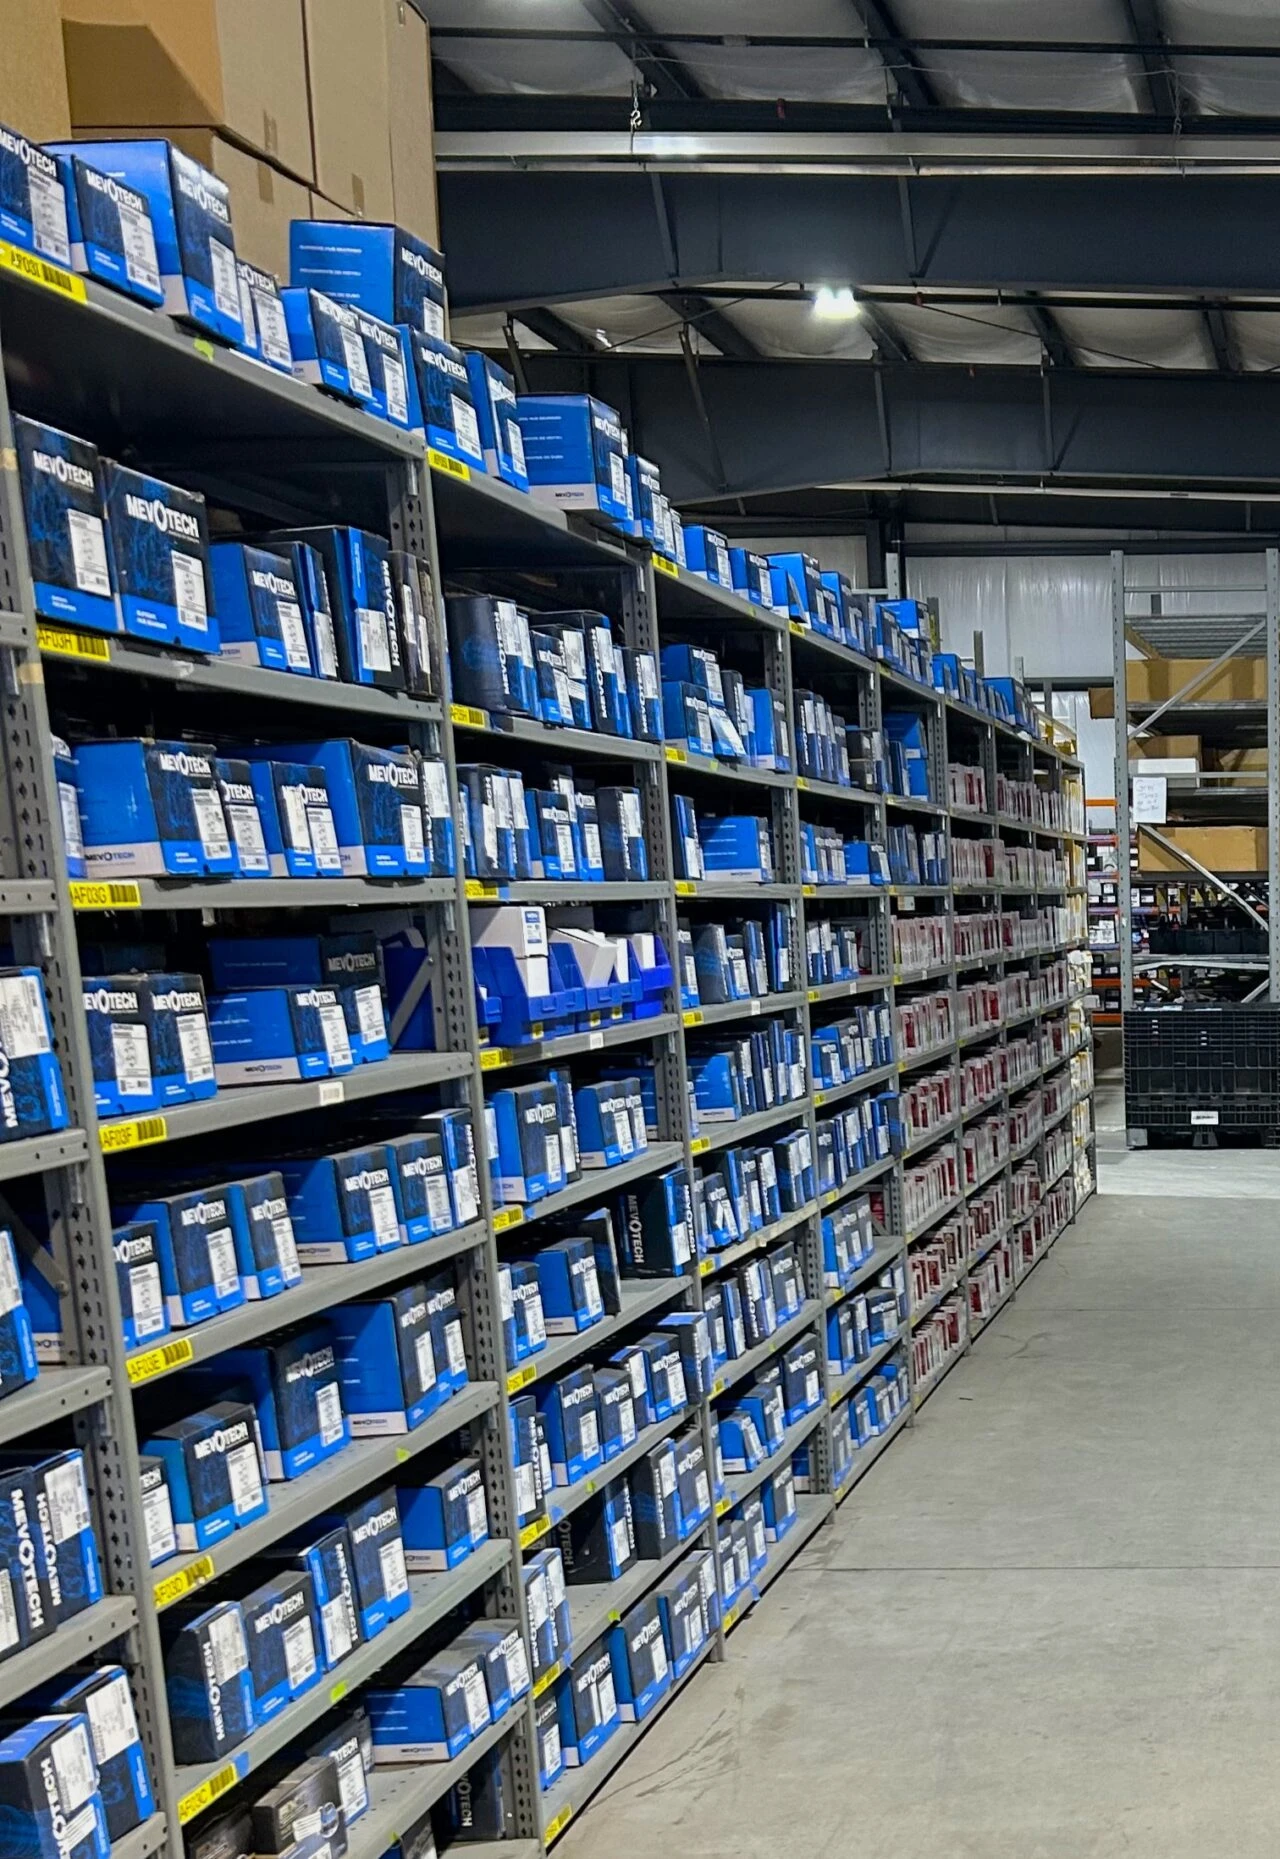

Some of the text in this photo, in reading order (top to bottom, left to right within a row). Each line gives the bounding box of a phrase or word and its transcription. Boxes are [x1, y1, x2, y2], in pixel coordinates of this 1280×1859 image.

[0, 127, 57, 177] MEVOTECH
[85, 169, 144, 212] MEVOTECH
[401, 246, 443, 285] MEVOTECH
[359, 318, 398, 353] MEVOTECH
[421, 346, 469, 384] MEVOTECH
[32, 450, 94, 489] MEVOTECH
[126, 493, 200, 538] MEVOTECH
[252, 568, 297, 597] MEVOTECH
[381, 559, 402, 668] MEVOTECH
[158, 751, 211, 777] MEVOTECH
[368, 761, 418, 788] MEVOTECH
[72, 882, 108, 905] AF03G
[328, 952, 376, 973] MEVOTECH
[82, 988, 138, 1015] EVOTECH
[151, 990, 202, 1012] MEVOTECH
[296, 987, 337, 1009] MEVOTECH
[101, 1126, 132, 1149] AF03F
[345, 1168, 390, 1192] MEVOTECH
[402, 1154, 443, 1178] MEVOTECH
[181, 1200, 228, 1227] MEVOTECH
[251, 1197, 289, 1222] MEVOTECH
[628, 1194, 644, 1264] MEVOTECH
[285, 1345, 335, 1383] MEVOTECH
[195, 1422, 250, 1460] MEVOTECH
[449, 1470, 482, 1502] MEVOTECH
[352, 1507, 398, 1544] MEVOTECH
[10, 1488, 45, 1630] MEVOTECH
[335, 1543, 359, 1643] MEVOTECH
[254, 1591, 305, 1634] MEVOTECH
[202, 1641, 226, 1742] MEVOTECH
[447, 1663, 478, 1697] MEVOTECH
